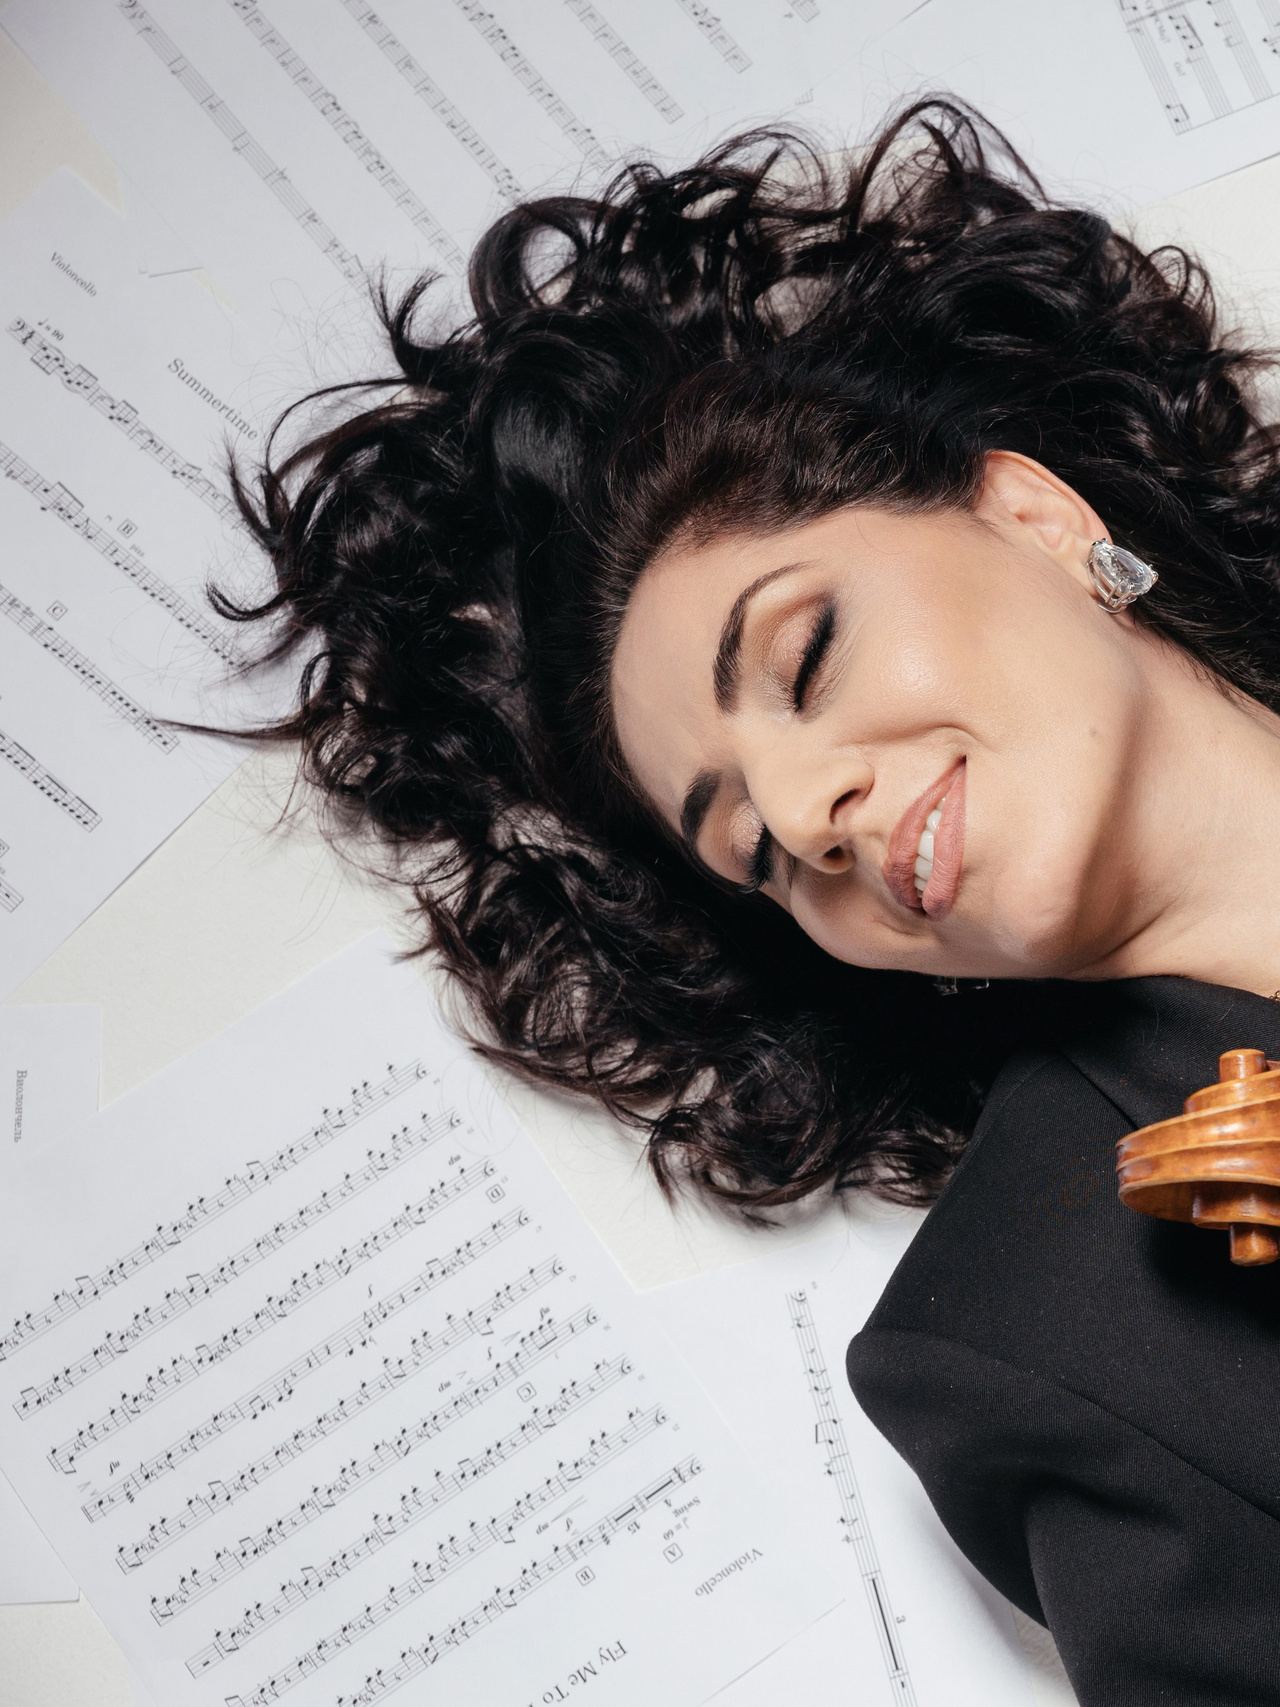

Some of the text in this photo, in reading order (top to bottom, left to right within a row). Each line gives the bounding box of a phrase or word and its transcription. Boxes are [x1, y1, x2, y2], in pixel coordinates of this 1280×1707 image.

[50, 251, 97, 297] Violoncello
[51, 329, 65, 342] 90
[167, 358, 258, 439] Summertime
[13, 1069, 28, 1144] Виолончель
[627, 1520, 641, 1534] 15
[672, 1496, 701, 1518] Swing
[662, 1529, 675, 1541] 60
[694, 1548, 764, 1597] Violoncello
[542, 1640, 628, 1704] Fly Me To
